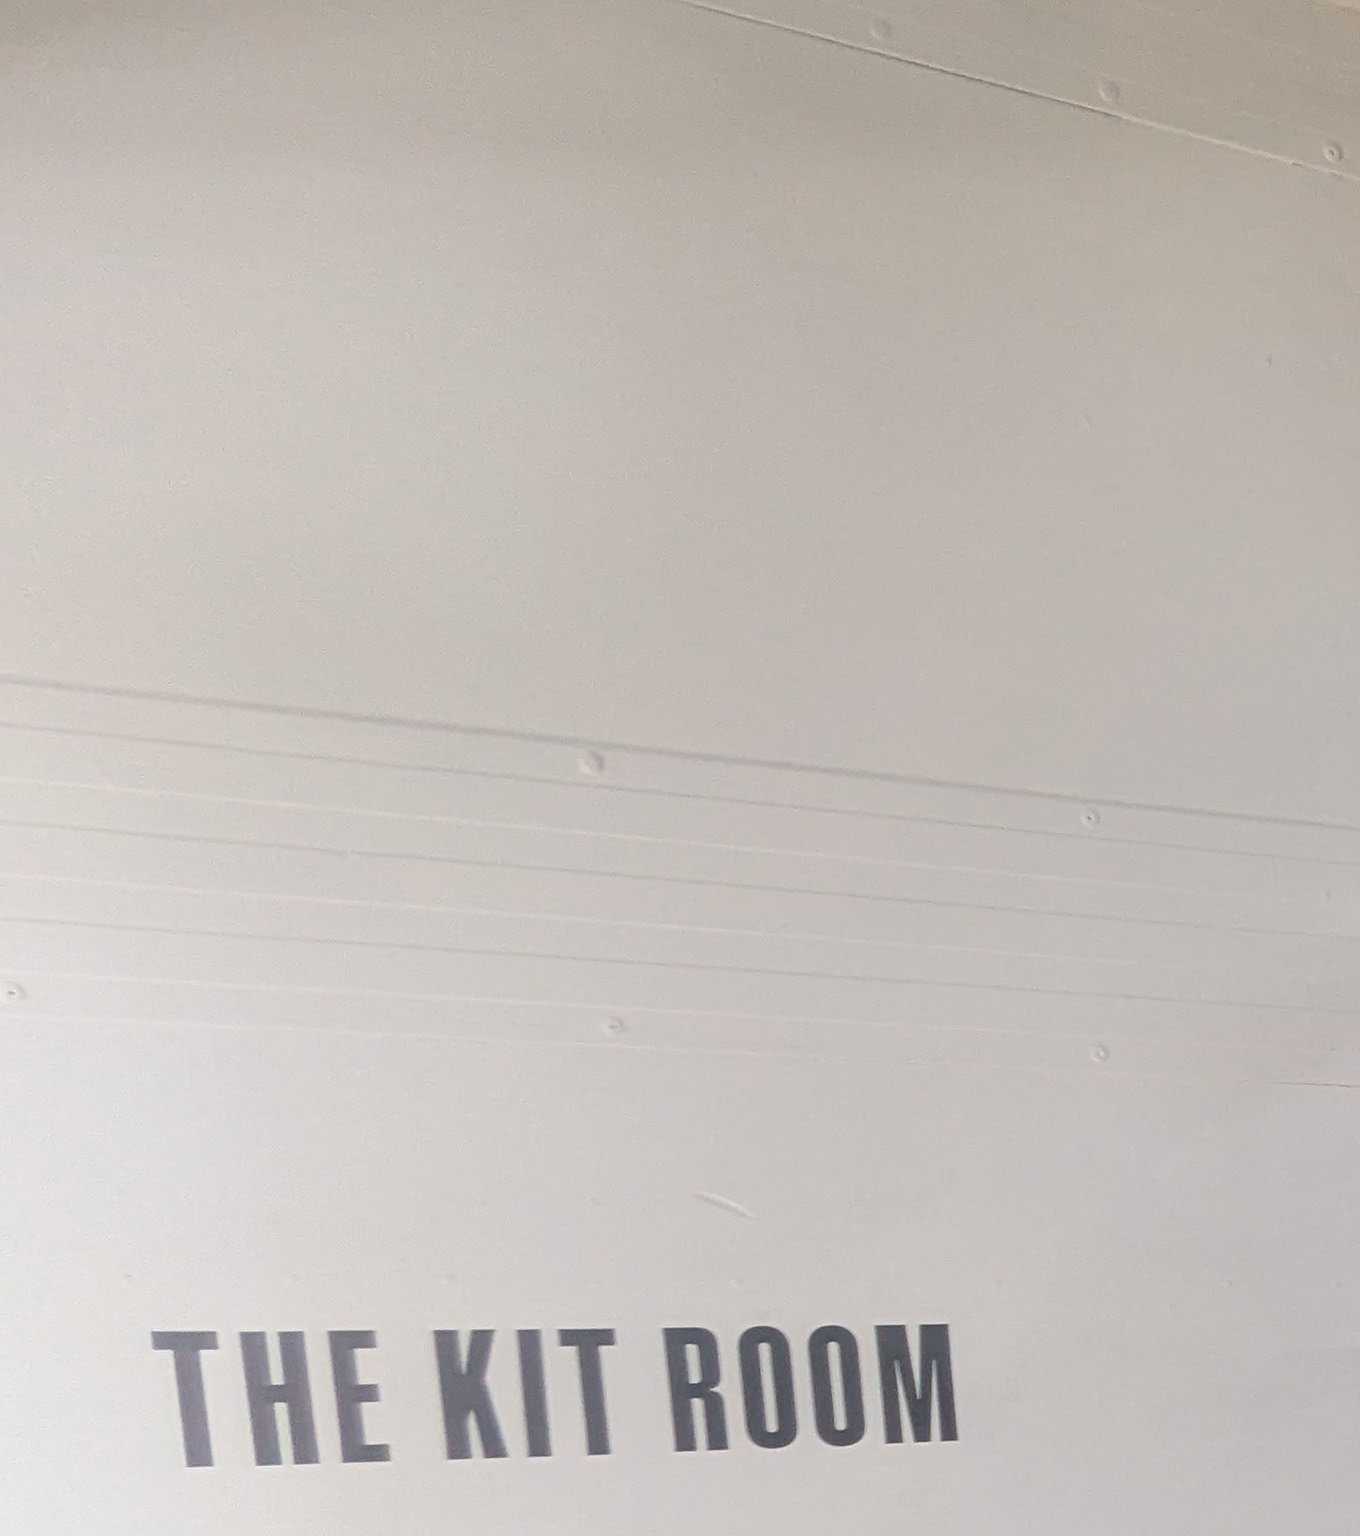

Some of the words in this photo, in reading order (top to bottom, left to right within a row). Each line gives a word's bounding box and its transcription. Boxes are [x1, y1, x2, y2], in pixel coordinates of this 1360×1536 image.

[150, 1329, 392, 1468] THE
[434, 1326, 618, 1461] KIT
[662, 1323, 960, 1452] ROOM
